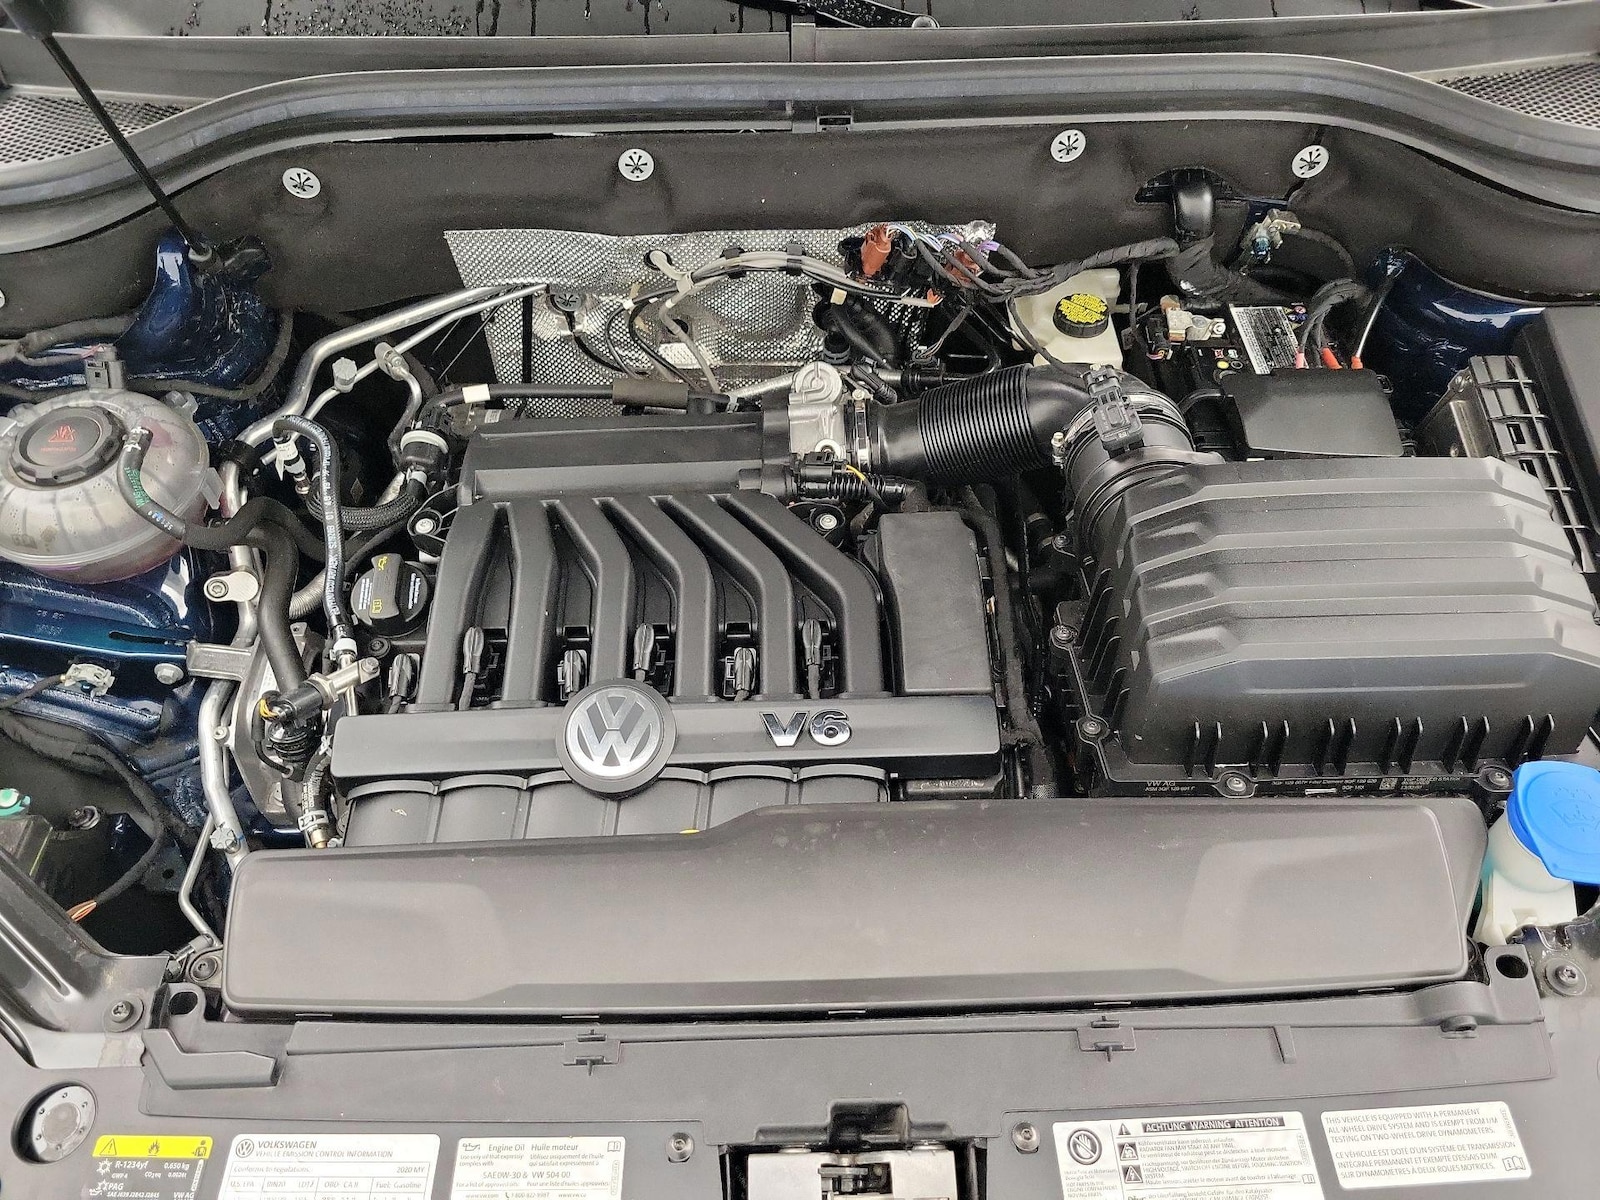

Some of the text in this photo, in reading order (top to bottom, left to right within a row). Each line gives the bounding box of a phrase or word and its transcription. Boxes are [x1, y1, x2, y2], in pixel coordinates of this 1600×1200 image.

[759, 708, 852, 747] V6
[1341, 1115, 1370, 1123] VEHICLE
[1378, 1112, 1412, 1122] EQUIPPED
[1413, 1111, 1432, 1119] WITH
[1440, 1108, 1480, 1117] PERMANENT
[1145, 1117, 1280, 1133] ACHTUNG WARNING ATTENTION
[1367, 1123, 1387, 1131] DRIVE
[1387, 1122, 1413, 1130] SYSTEM
[1414, 1120, 1430, 1128] AND
[1438, 1118, 1465, 1127] EXEMPT
[1466, 1117, 1486, 1125] FROM
[1330, 1135, 1360, 1143] TESTING
[1360, 1134, 1372, 1142] ON
[1416, 1130, 1437, 1138] DRIVE
[258, 1140, 318, 1149] VOLKSWAGEN
[488, 1143, 525, 1153] Engine Oil
[282, 1150, 314, 1158] EMISSION
[315, 1150, 345, 1158] CONTROL
[346, 1150, 394, 1158] INFORMATION
[1335, 1151, 1344, 1159] CE
[1378, 1148, 1389, 1156] EST
[1457, 1144, 1467, 1152] DE
[1467, 1141, 1516, 1151] TRANSMISSION
[114, 1160, 190, 1171] R-1234yf 0.650 kg
[1374, 1157, 1415, 1166] PERMANENT
[396, 1166, 413, 1174] 2020
[413, 1166, 425, 1174] MY
[546, 1171, 560, 1179] 504
[1340, 1171, 1355, 1179] SUR
[1417, 1166, 1437, 1174] DEUX
[1438, 1164, 1460, 1173] ROUES
[107, 1182, 125, 1191] PAG
[393, 1181, 422, 1189] Gasoline
